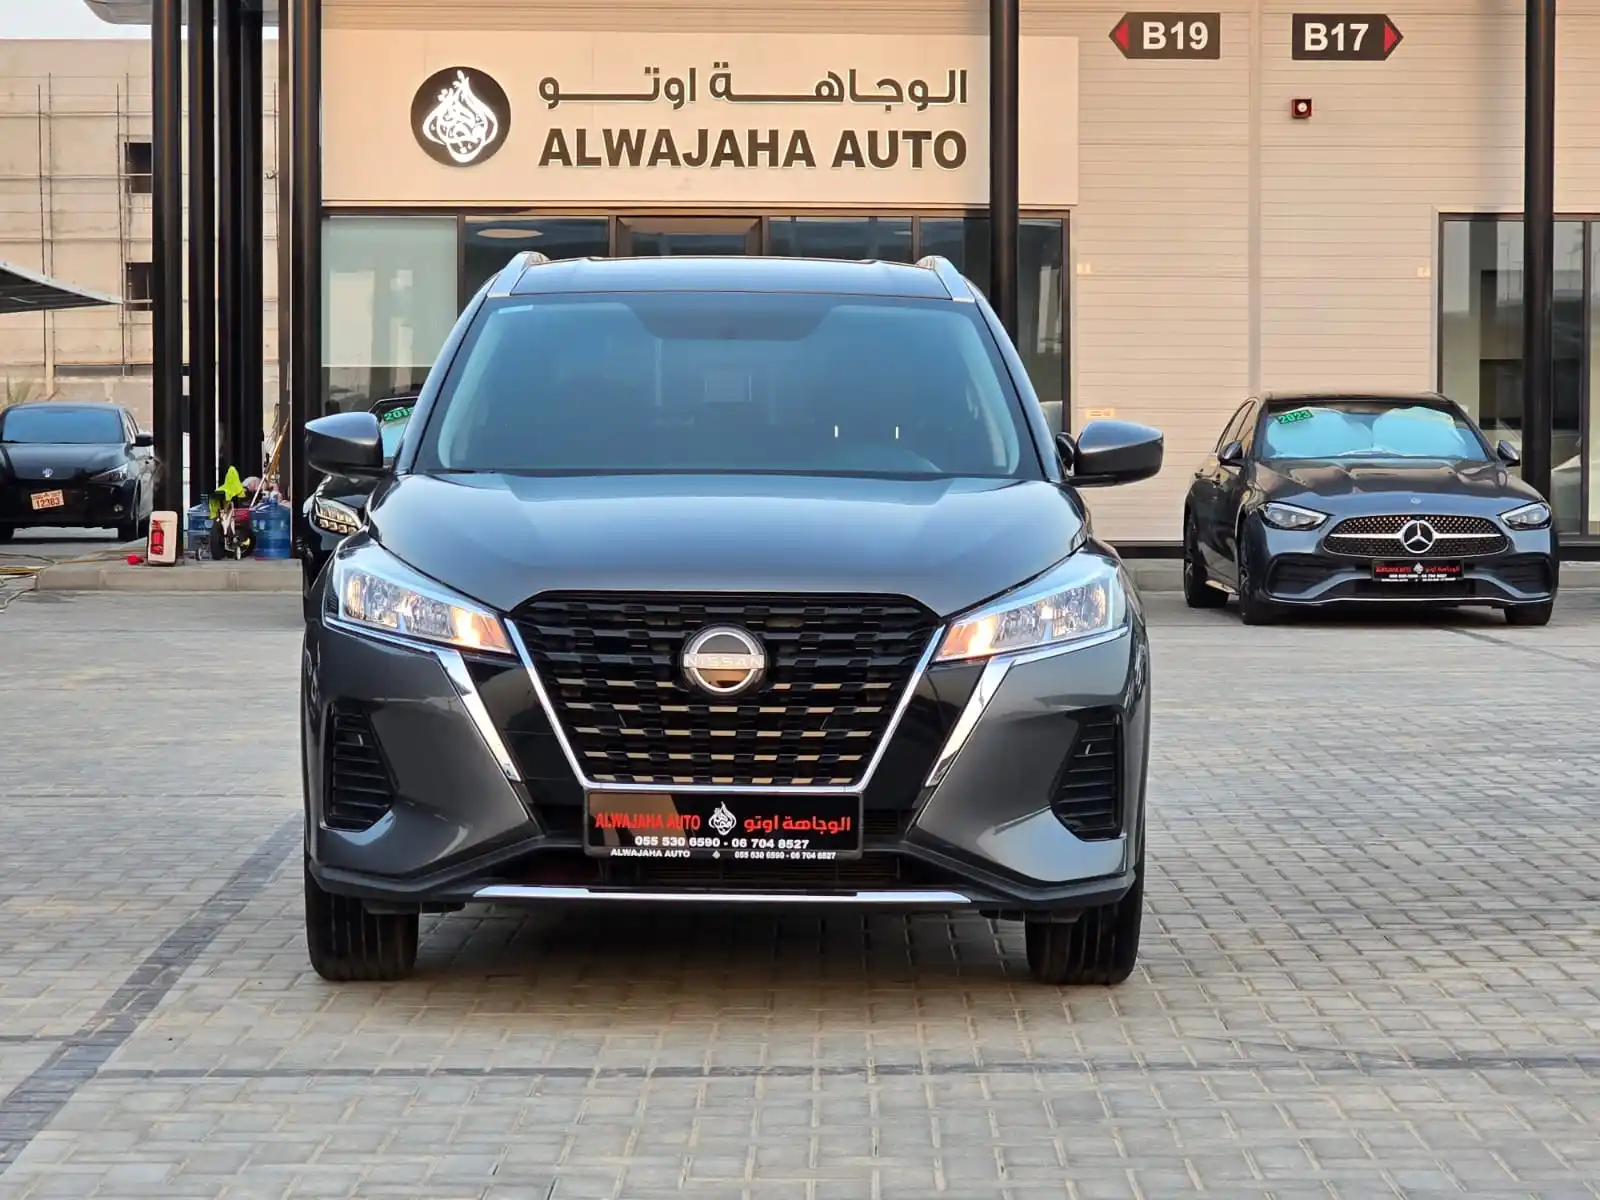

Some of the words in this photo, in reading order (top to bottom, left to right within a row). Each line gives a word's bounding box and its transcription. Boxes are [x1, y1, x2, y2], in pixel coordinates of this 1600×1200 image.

[1142, 21, 1209, 50] B19
[1304, 22, 1370, 52] B17
[538, 66, 697, 110] اوتو
[709, 61, 968, 112] الوجاهة
[537, 128, 817, 168] ALWAJAHA
[831, 129, 968, 170] AUTO
[684, 654, 763, 668] NISSAN
[595, 812, 663, 829] ALWAJAHA
[667, 813, 701, 831] AUTO
[743, 815, 779, 833] اوتو
[782, 815, 851, 835] الوجاهة
[634, 835, 659, 847] 055
[662, 836, 686, 847] 530
[750, 838, 775, 849] 704
[610, 848, 662, 857] ALWAJAHA
[664, 849, 691, 858] AUTO
